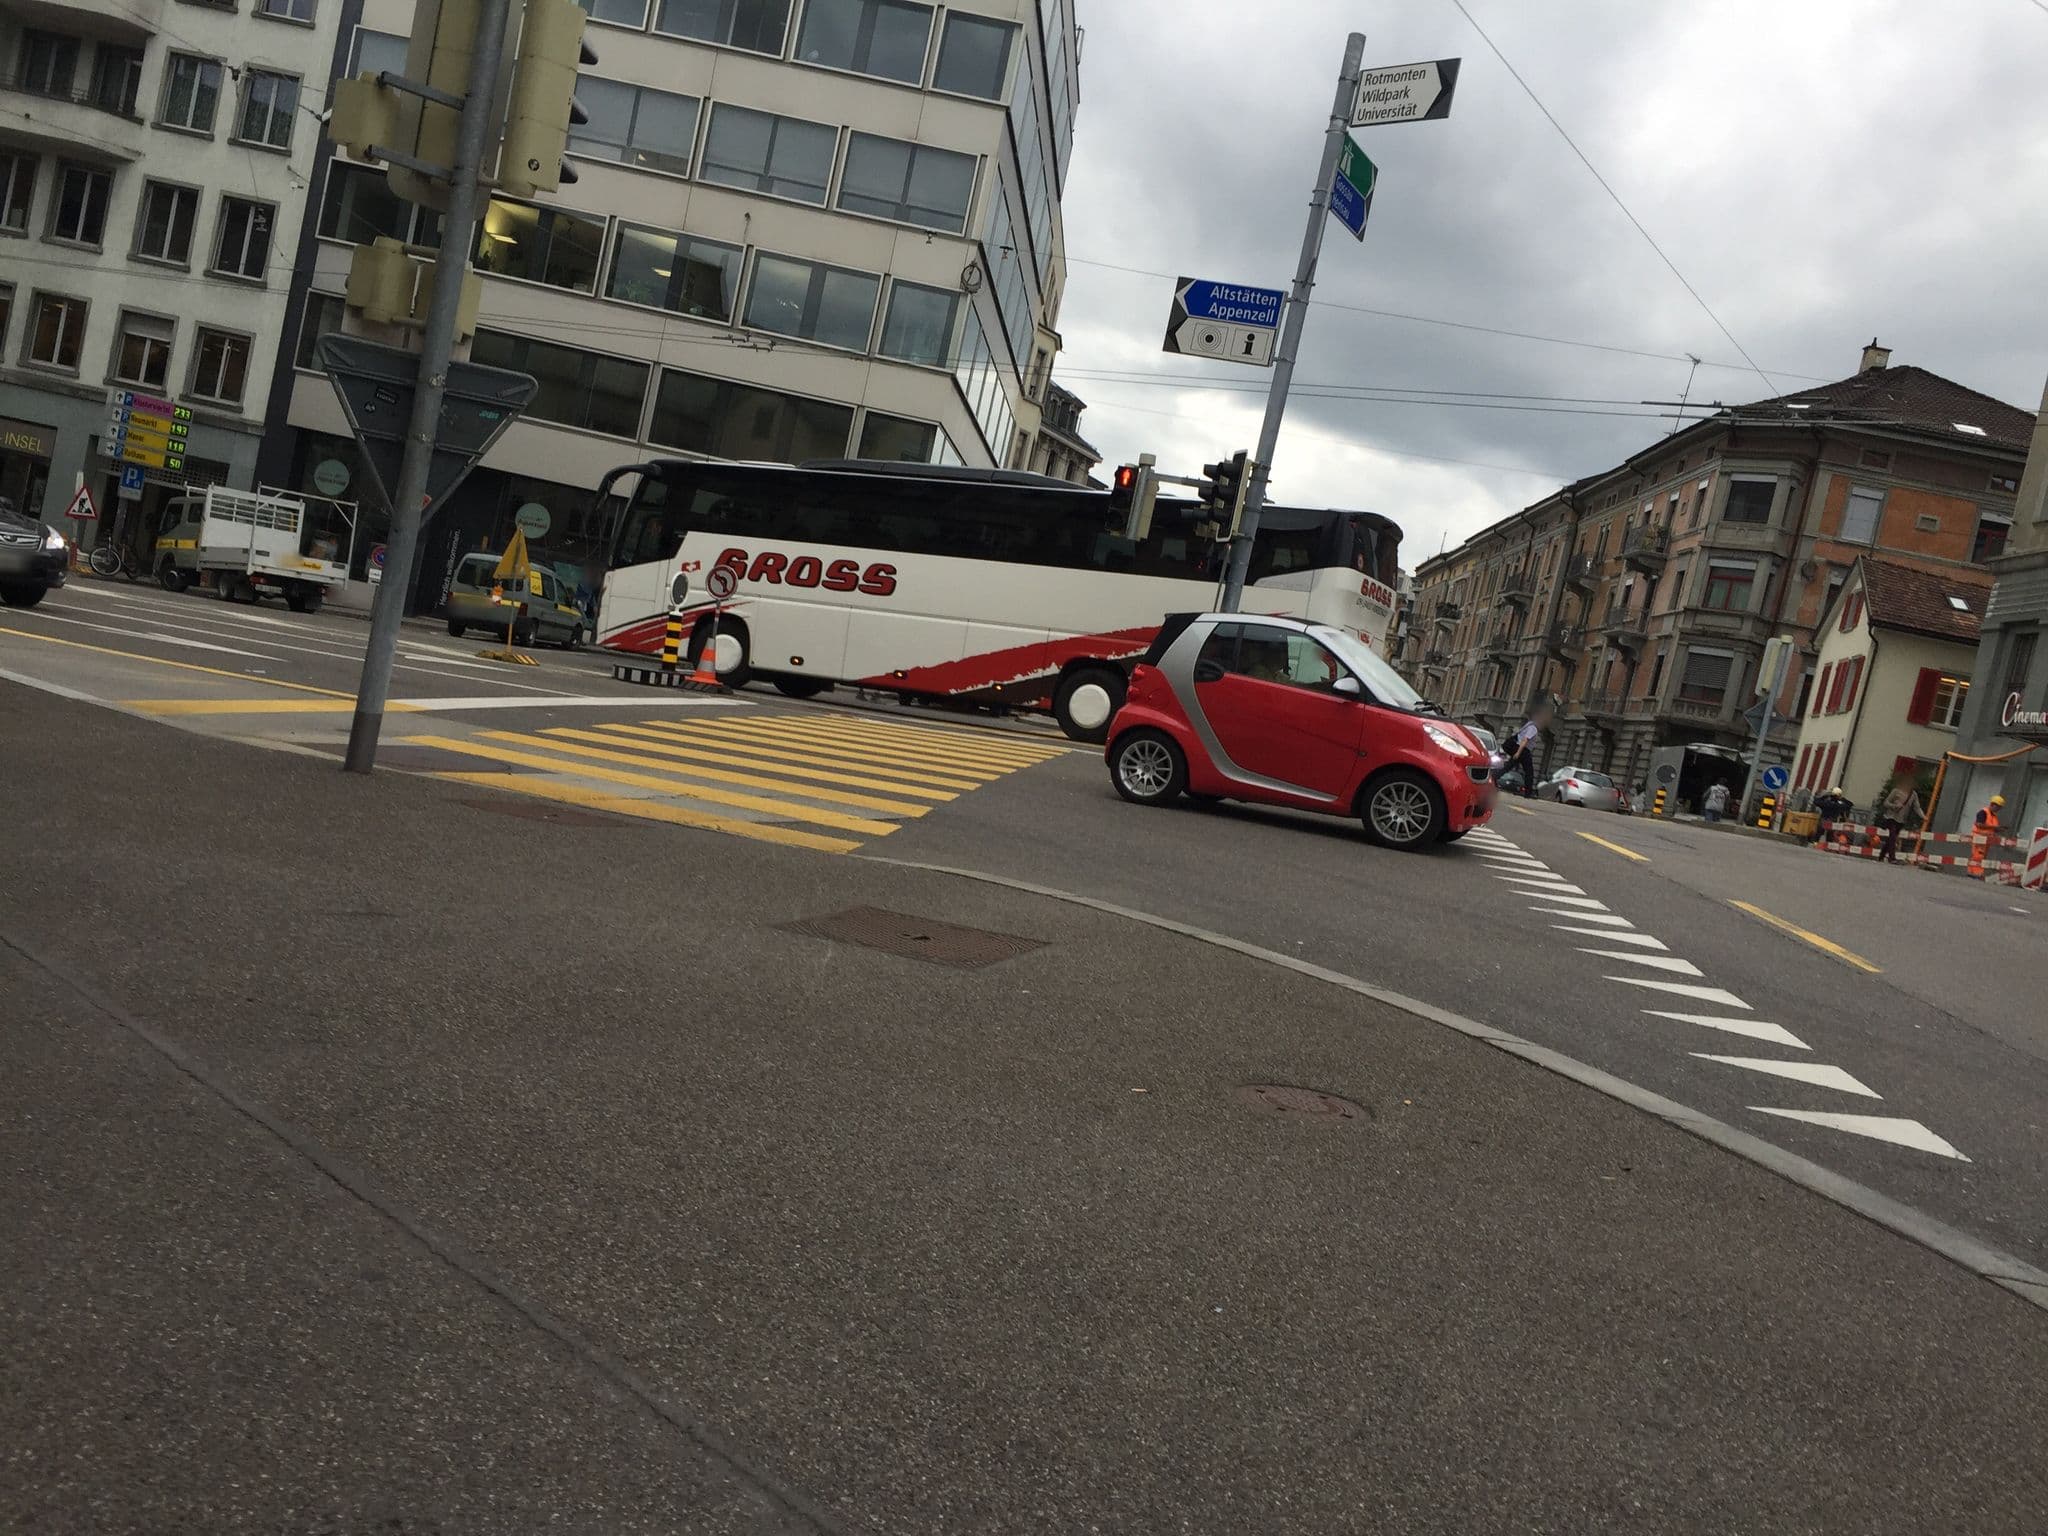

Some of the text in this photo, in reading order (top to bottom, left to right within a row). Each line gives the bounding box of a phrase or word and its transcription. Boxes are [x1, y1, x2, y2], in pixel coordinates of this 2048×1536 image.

[1364, 69, 1427, 87] Rotmonten
[1362, 85, 1411, 105] Wildpark
[1357, 103, 1418, 121] Universität
[1210, 285, 1278, 307] Altstätten
[1208, 302, 1276, 324] Appenzell
[174, 407, 192, 419] 233
[170, 422, 188, 434] 193
[167, 440, 185, 453] 118
[169, 458, 181, 469] 50
[713, 547, 898, 597] GROSS
